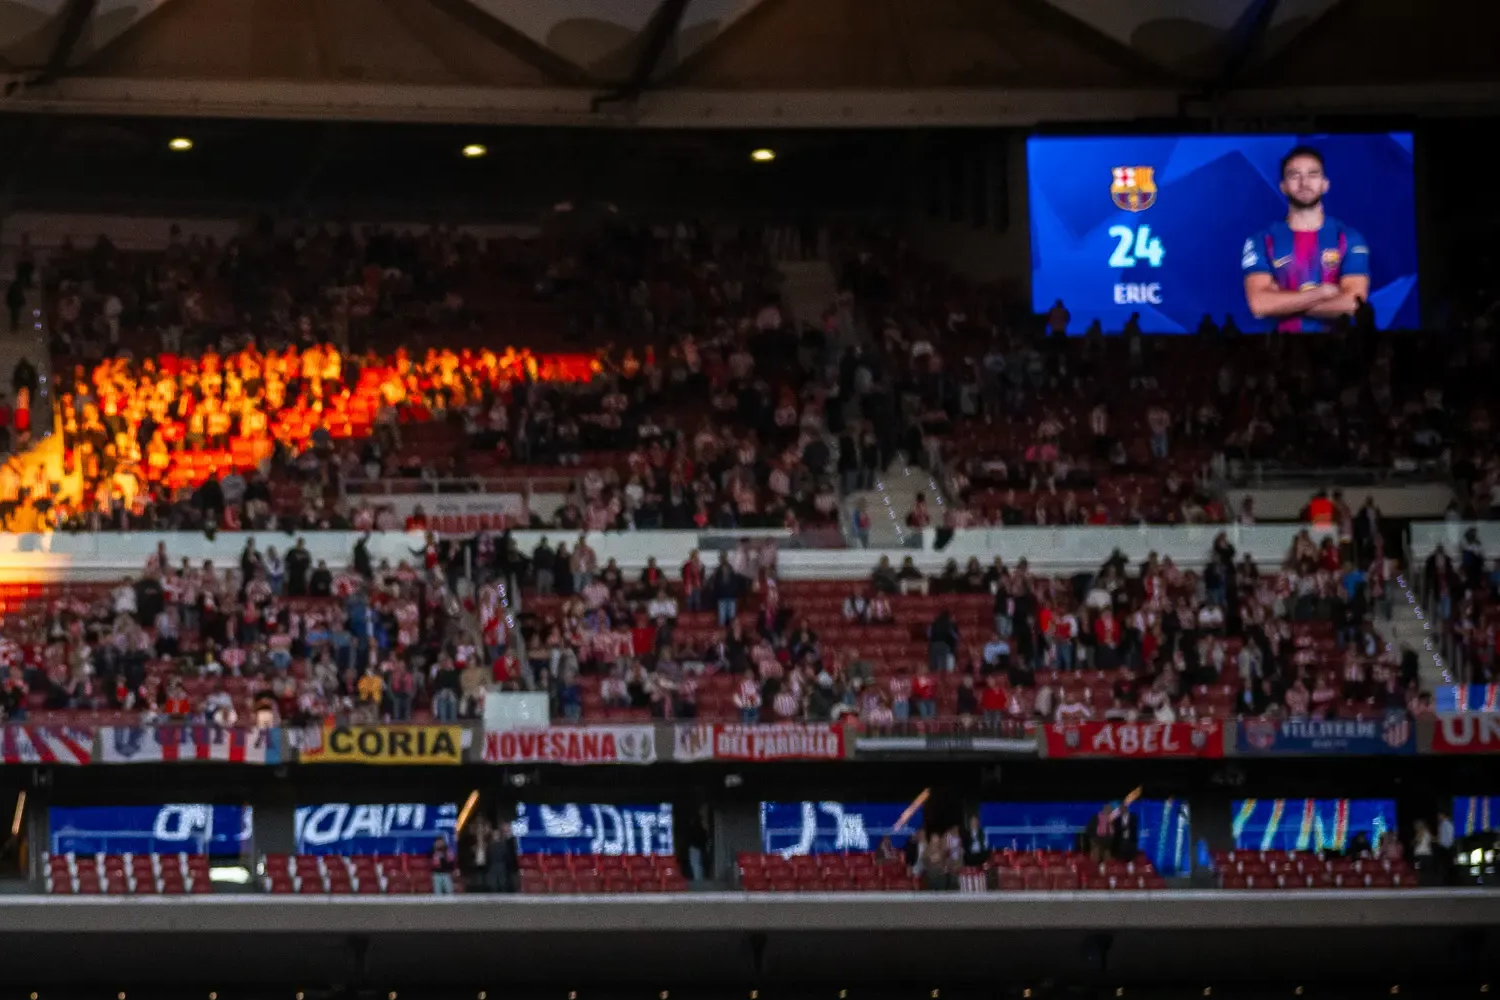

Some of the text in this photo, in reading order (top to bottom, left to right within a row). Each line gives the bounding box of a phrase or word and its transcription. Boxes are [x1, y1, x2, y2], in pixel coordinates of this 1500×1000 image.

[1108, 224, 1166, 269] 24
[1113, 282, 1163, 305] ERIC
[328, 729, 458, 757] CORIA
[1092, 724, 1179, 752] ABEL
